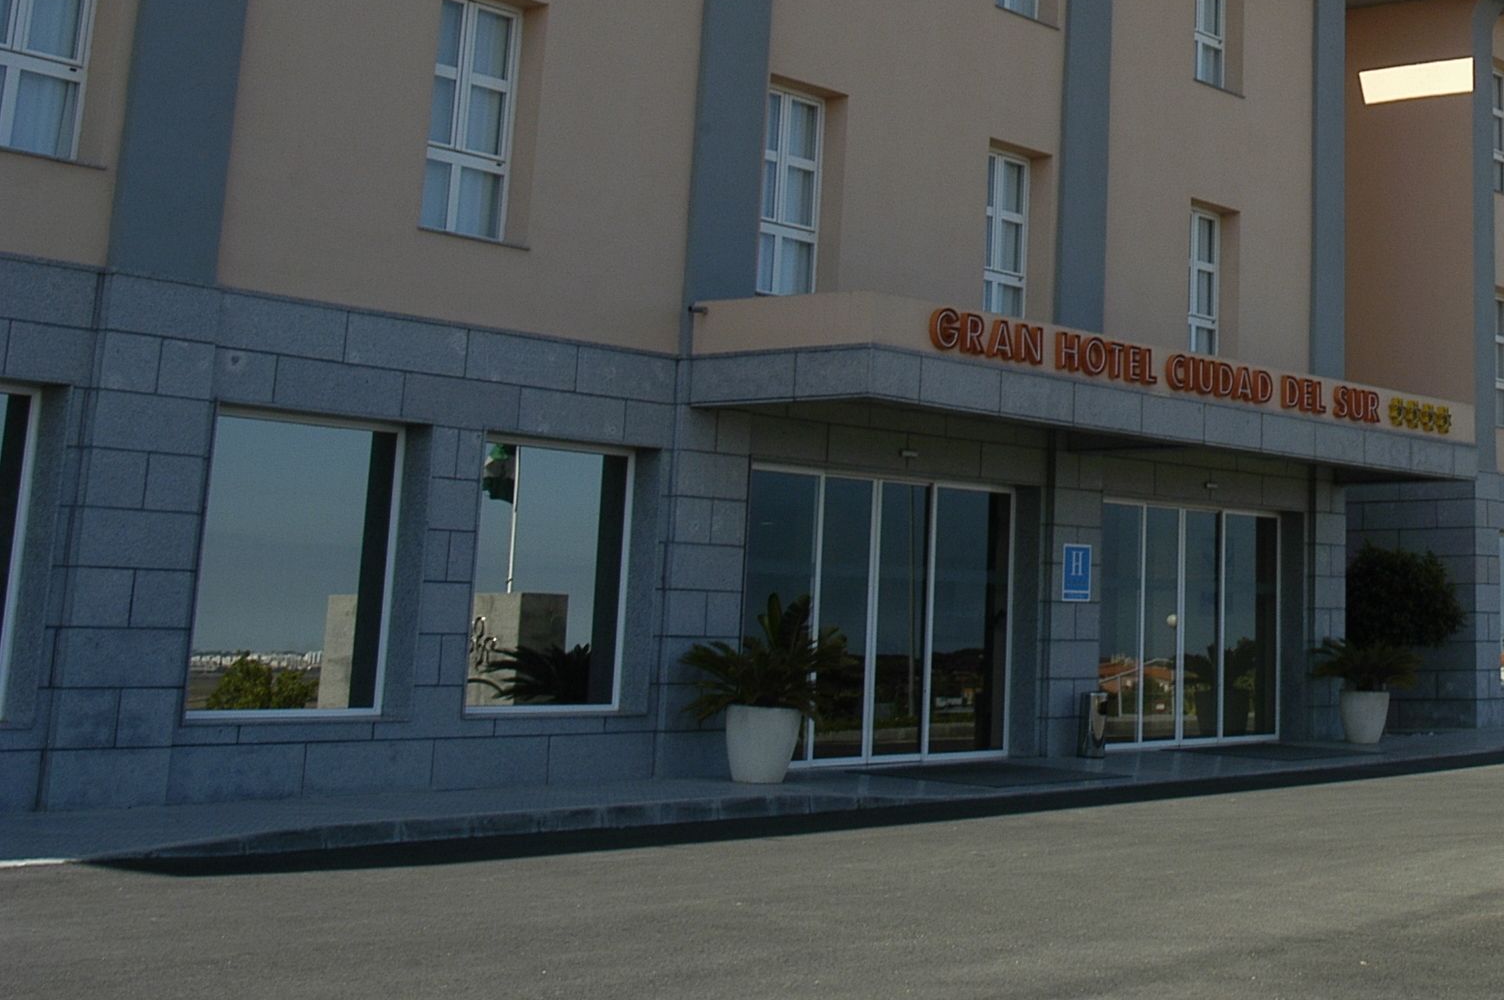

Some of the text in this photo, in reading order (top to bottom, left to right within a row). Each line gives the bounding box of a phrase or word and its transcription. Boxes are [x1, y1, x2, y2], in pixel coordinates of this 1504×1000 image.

[929, 307, 1380, 423] GRAN HOTEL CIUDAD DEL SUR
[1071, 551, 1084, 576] H
